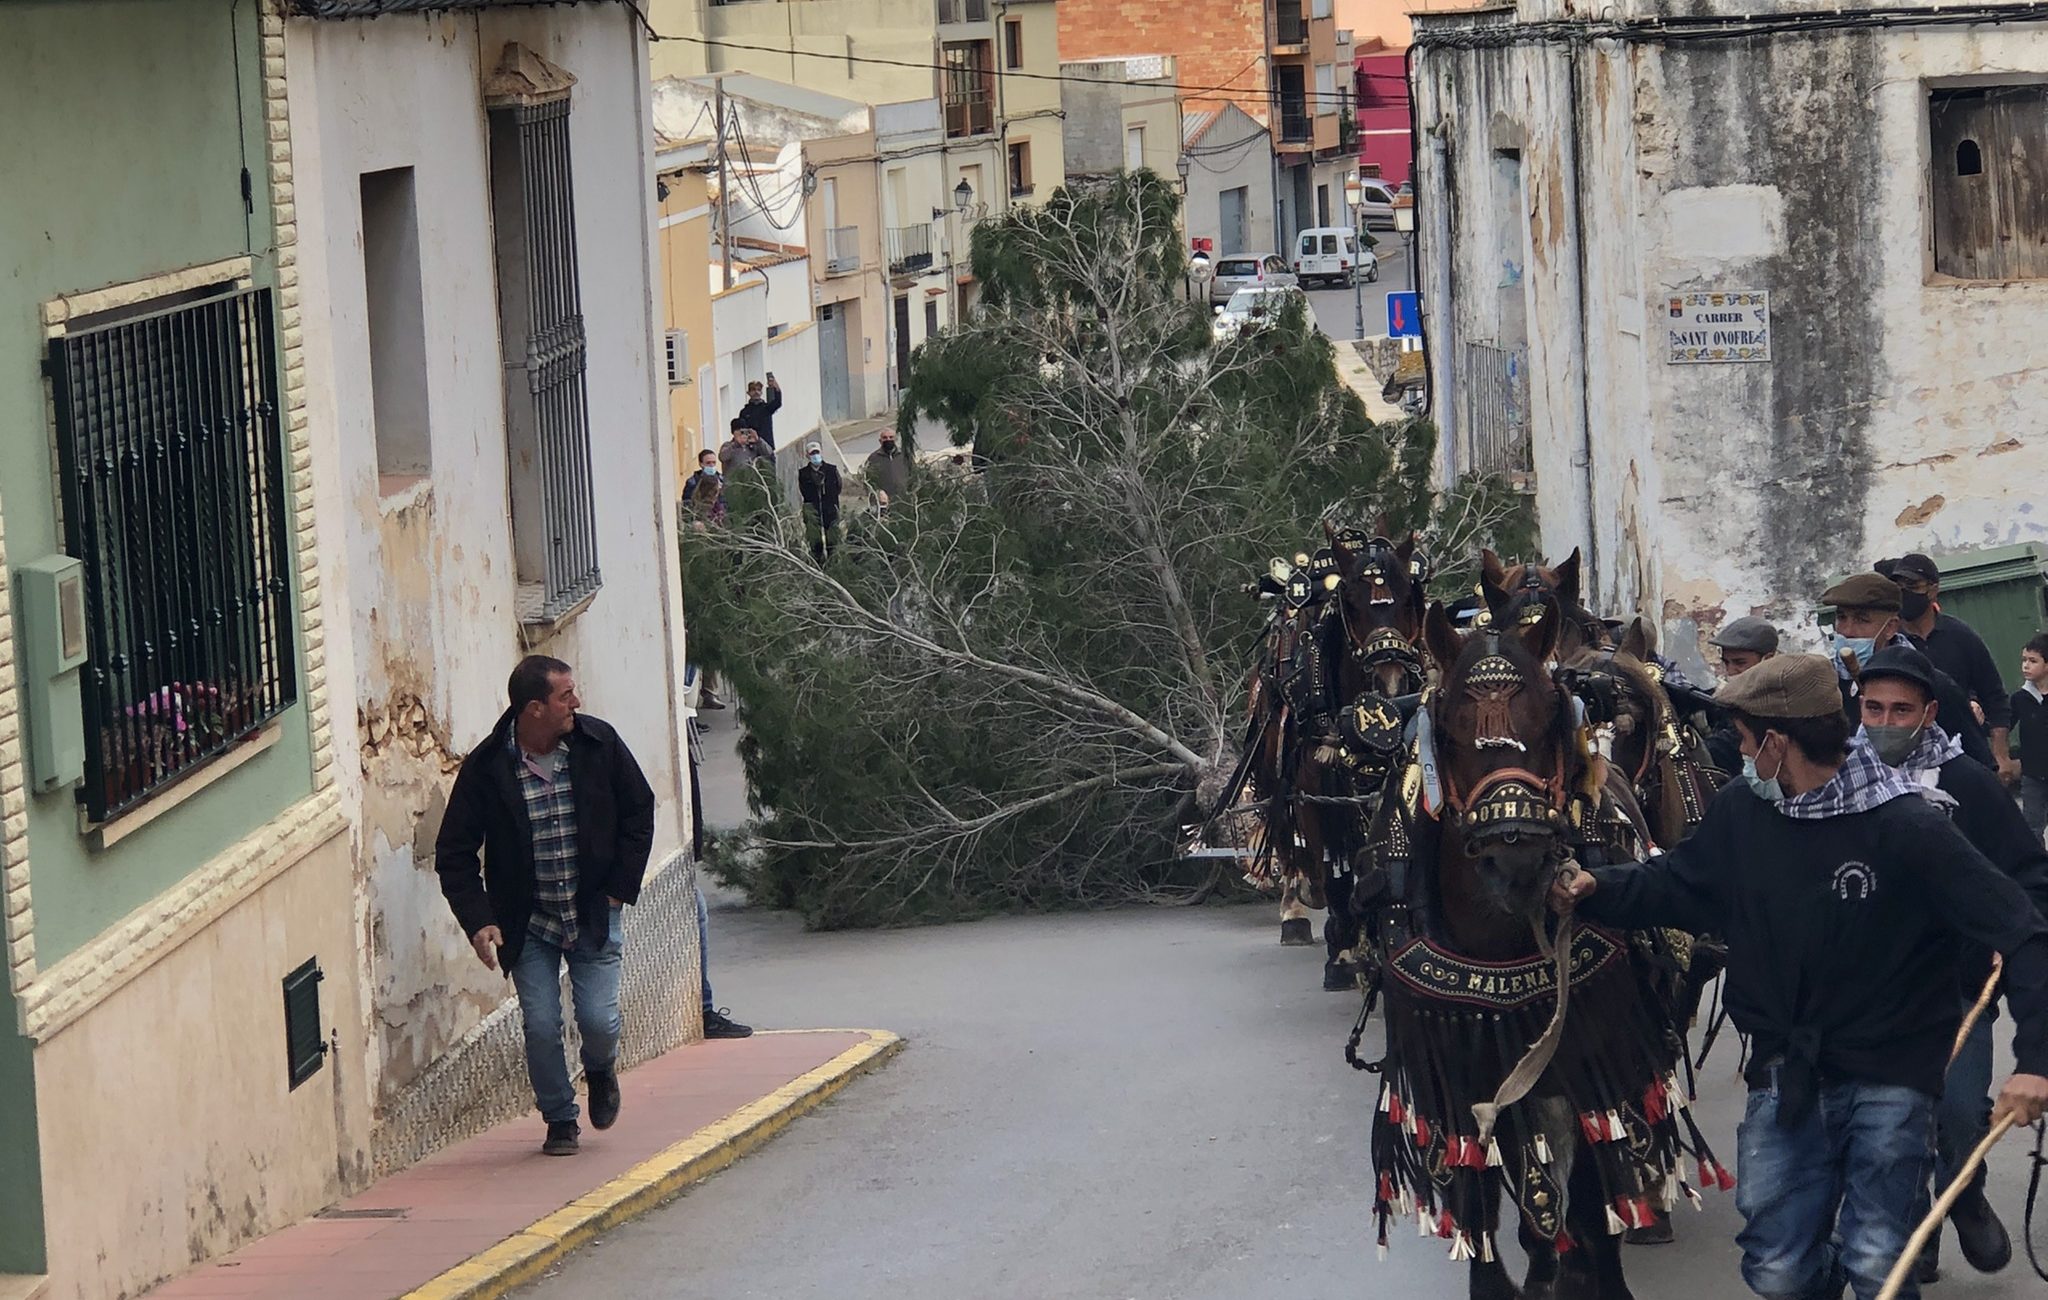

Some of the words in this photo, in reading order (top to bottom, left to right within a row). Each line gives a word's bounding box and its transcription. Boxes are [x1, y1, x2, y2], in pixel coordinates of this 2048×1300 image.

[1696, 313, 1743, 323] CARRER
[1682, 331, 1708, 346] SANT
[1713, 330, 1755, 346] ONOFRE
[1341, 540, 1364, 550] NOS
[1293, 583, 1305, 597] M
[1356, 706, 1400, 732] AL
[1467, 968, 1550, 994] MALENA
